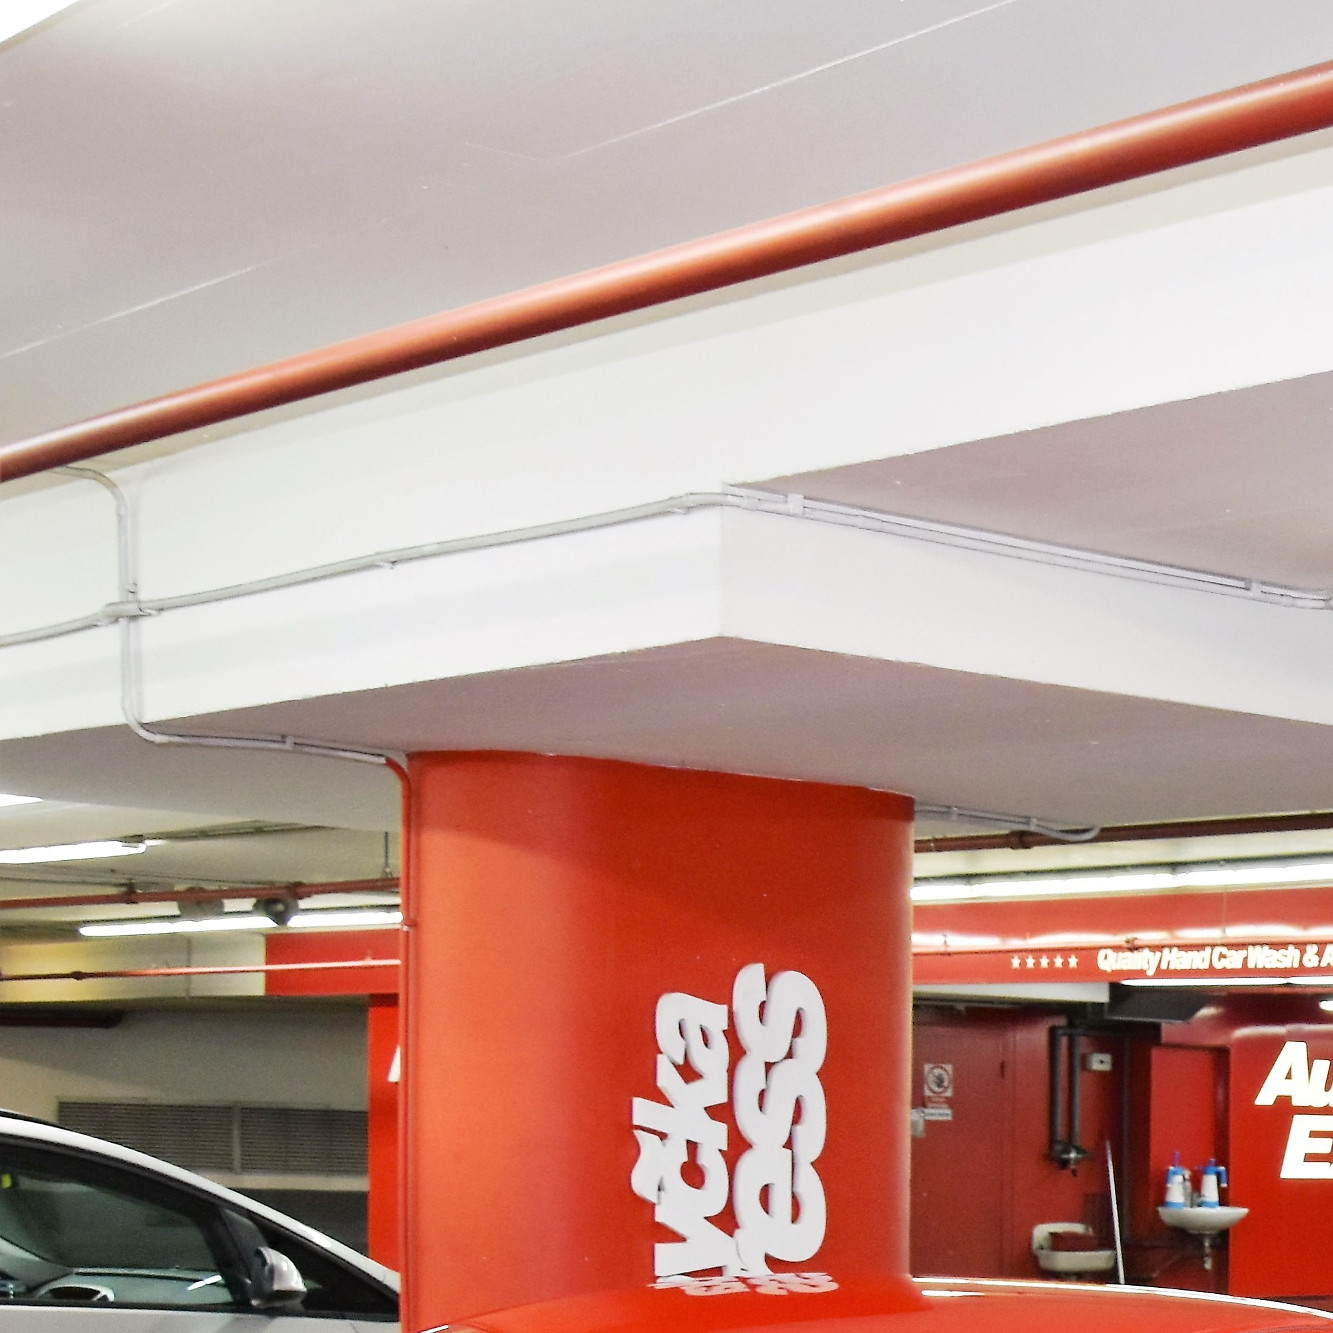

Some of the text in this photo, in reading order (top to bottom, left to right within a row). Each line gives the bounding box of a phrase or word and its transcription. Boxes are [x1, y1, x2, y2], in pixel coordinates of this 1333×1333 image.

[1160, 946, 1212, 970] Hand
[1211, 946, 1248, 969] Car
[1247, 944, 1300, 969] Wash
[1302, 943, 1320, 967] &
